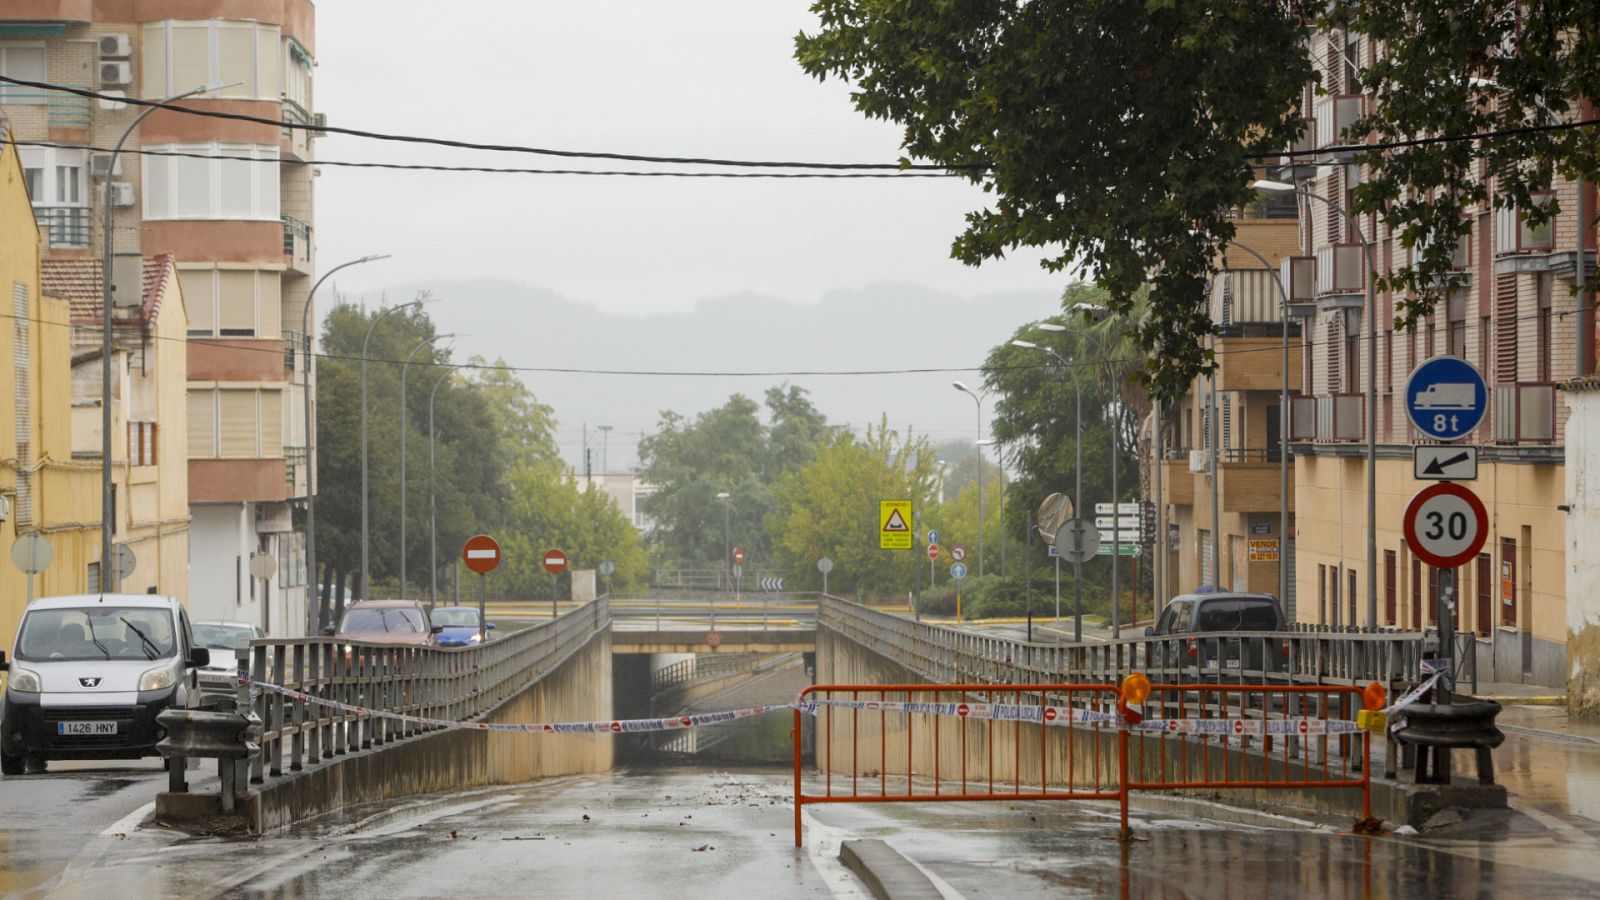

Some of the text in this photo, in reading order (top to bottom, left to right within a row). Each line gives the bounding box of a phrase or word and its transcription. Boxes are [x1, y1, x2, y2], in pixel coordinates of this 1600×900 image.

[1425, 511, 1467, 541] 30
[1000, 706, 1020, 719] POLICIA
[1021, 707, 1037, 720] LOCAL
[68, 723, 115, 733] 1426 HNY
